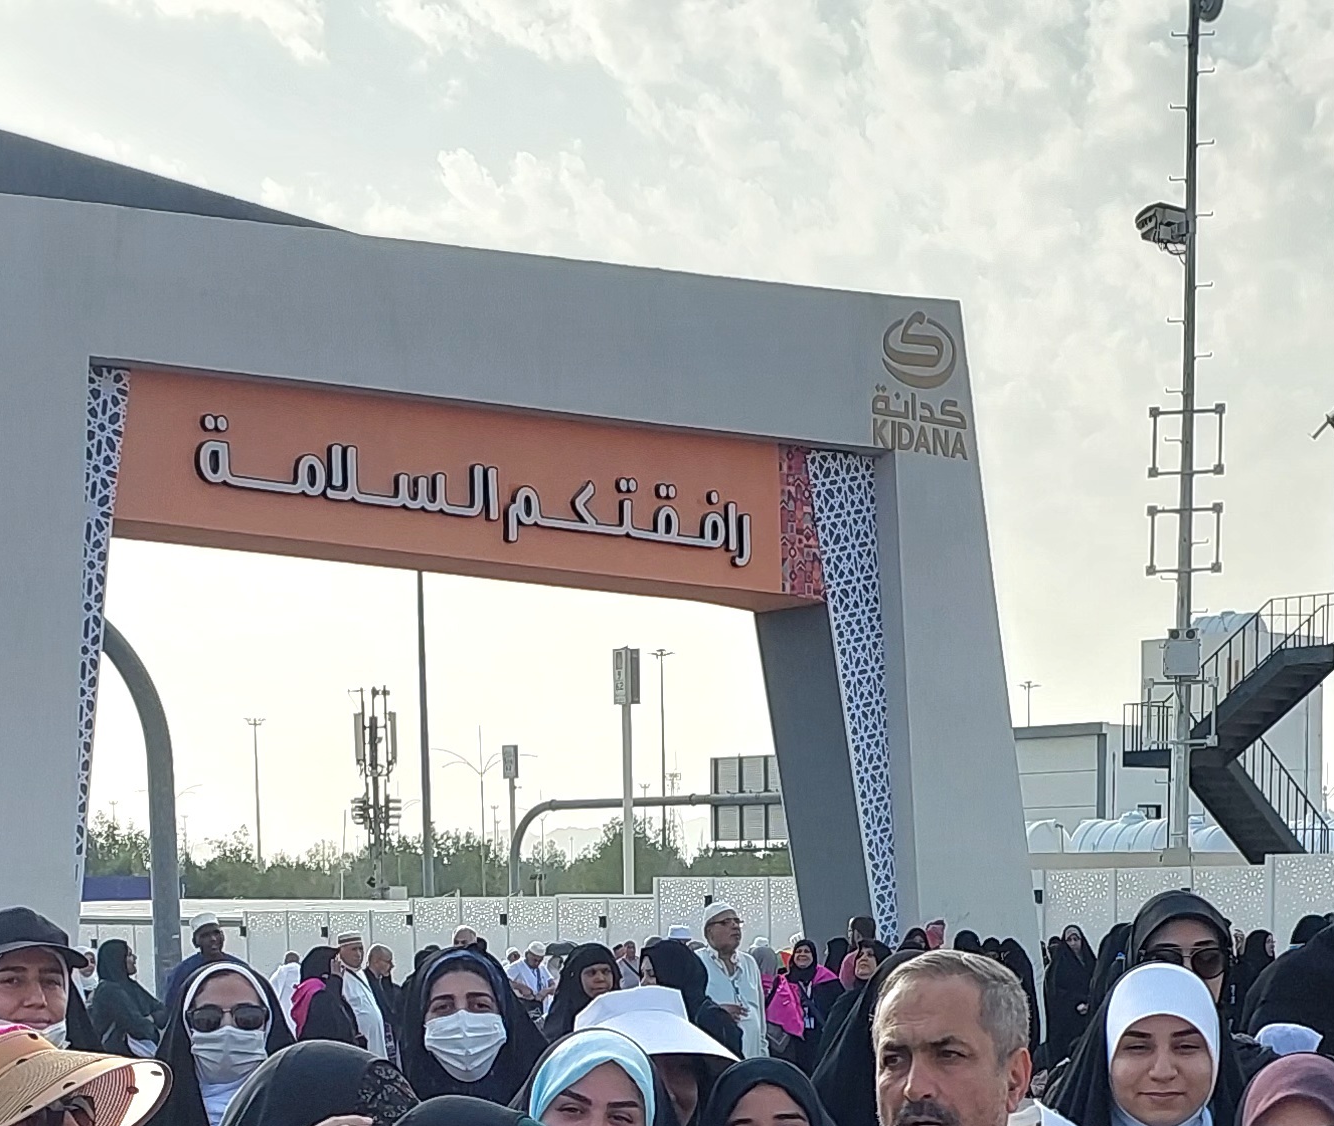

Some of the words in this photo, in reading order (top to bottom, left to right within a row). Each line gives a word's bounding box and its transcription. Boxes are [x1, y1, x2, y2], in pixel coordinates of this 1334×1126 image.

[871, 383, 968, 429] كدانة
[872, 417, 969, 461] KIDANA
[194, 413, 500, 522] السلامة
[503, 476, 752, 568] رافقتكم
